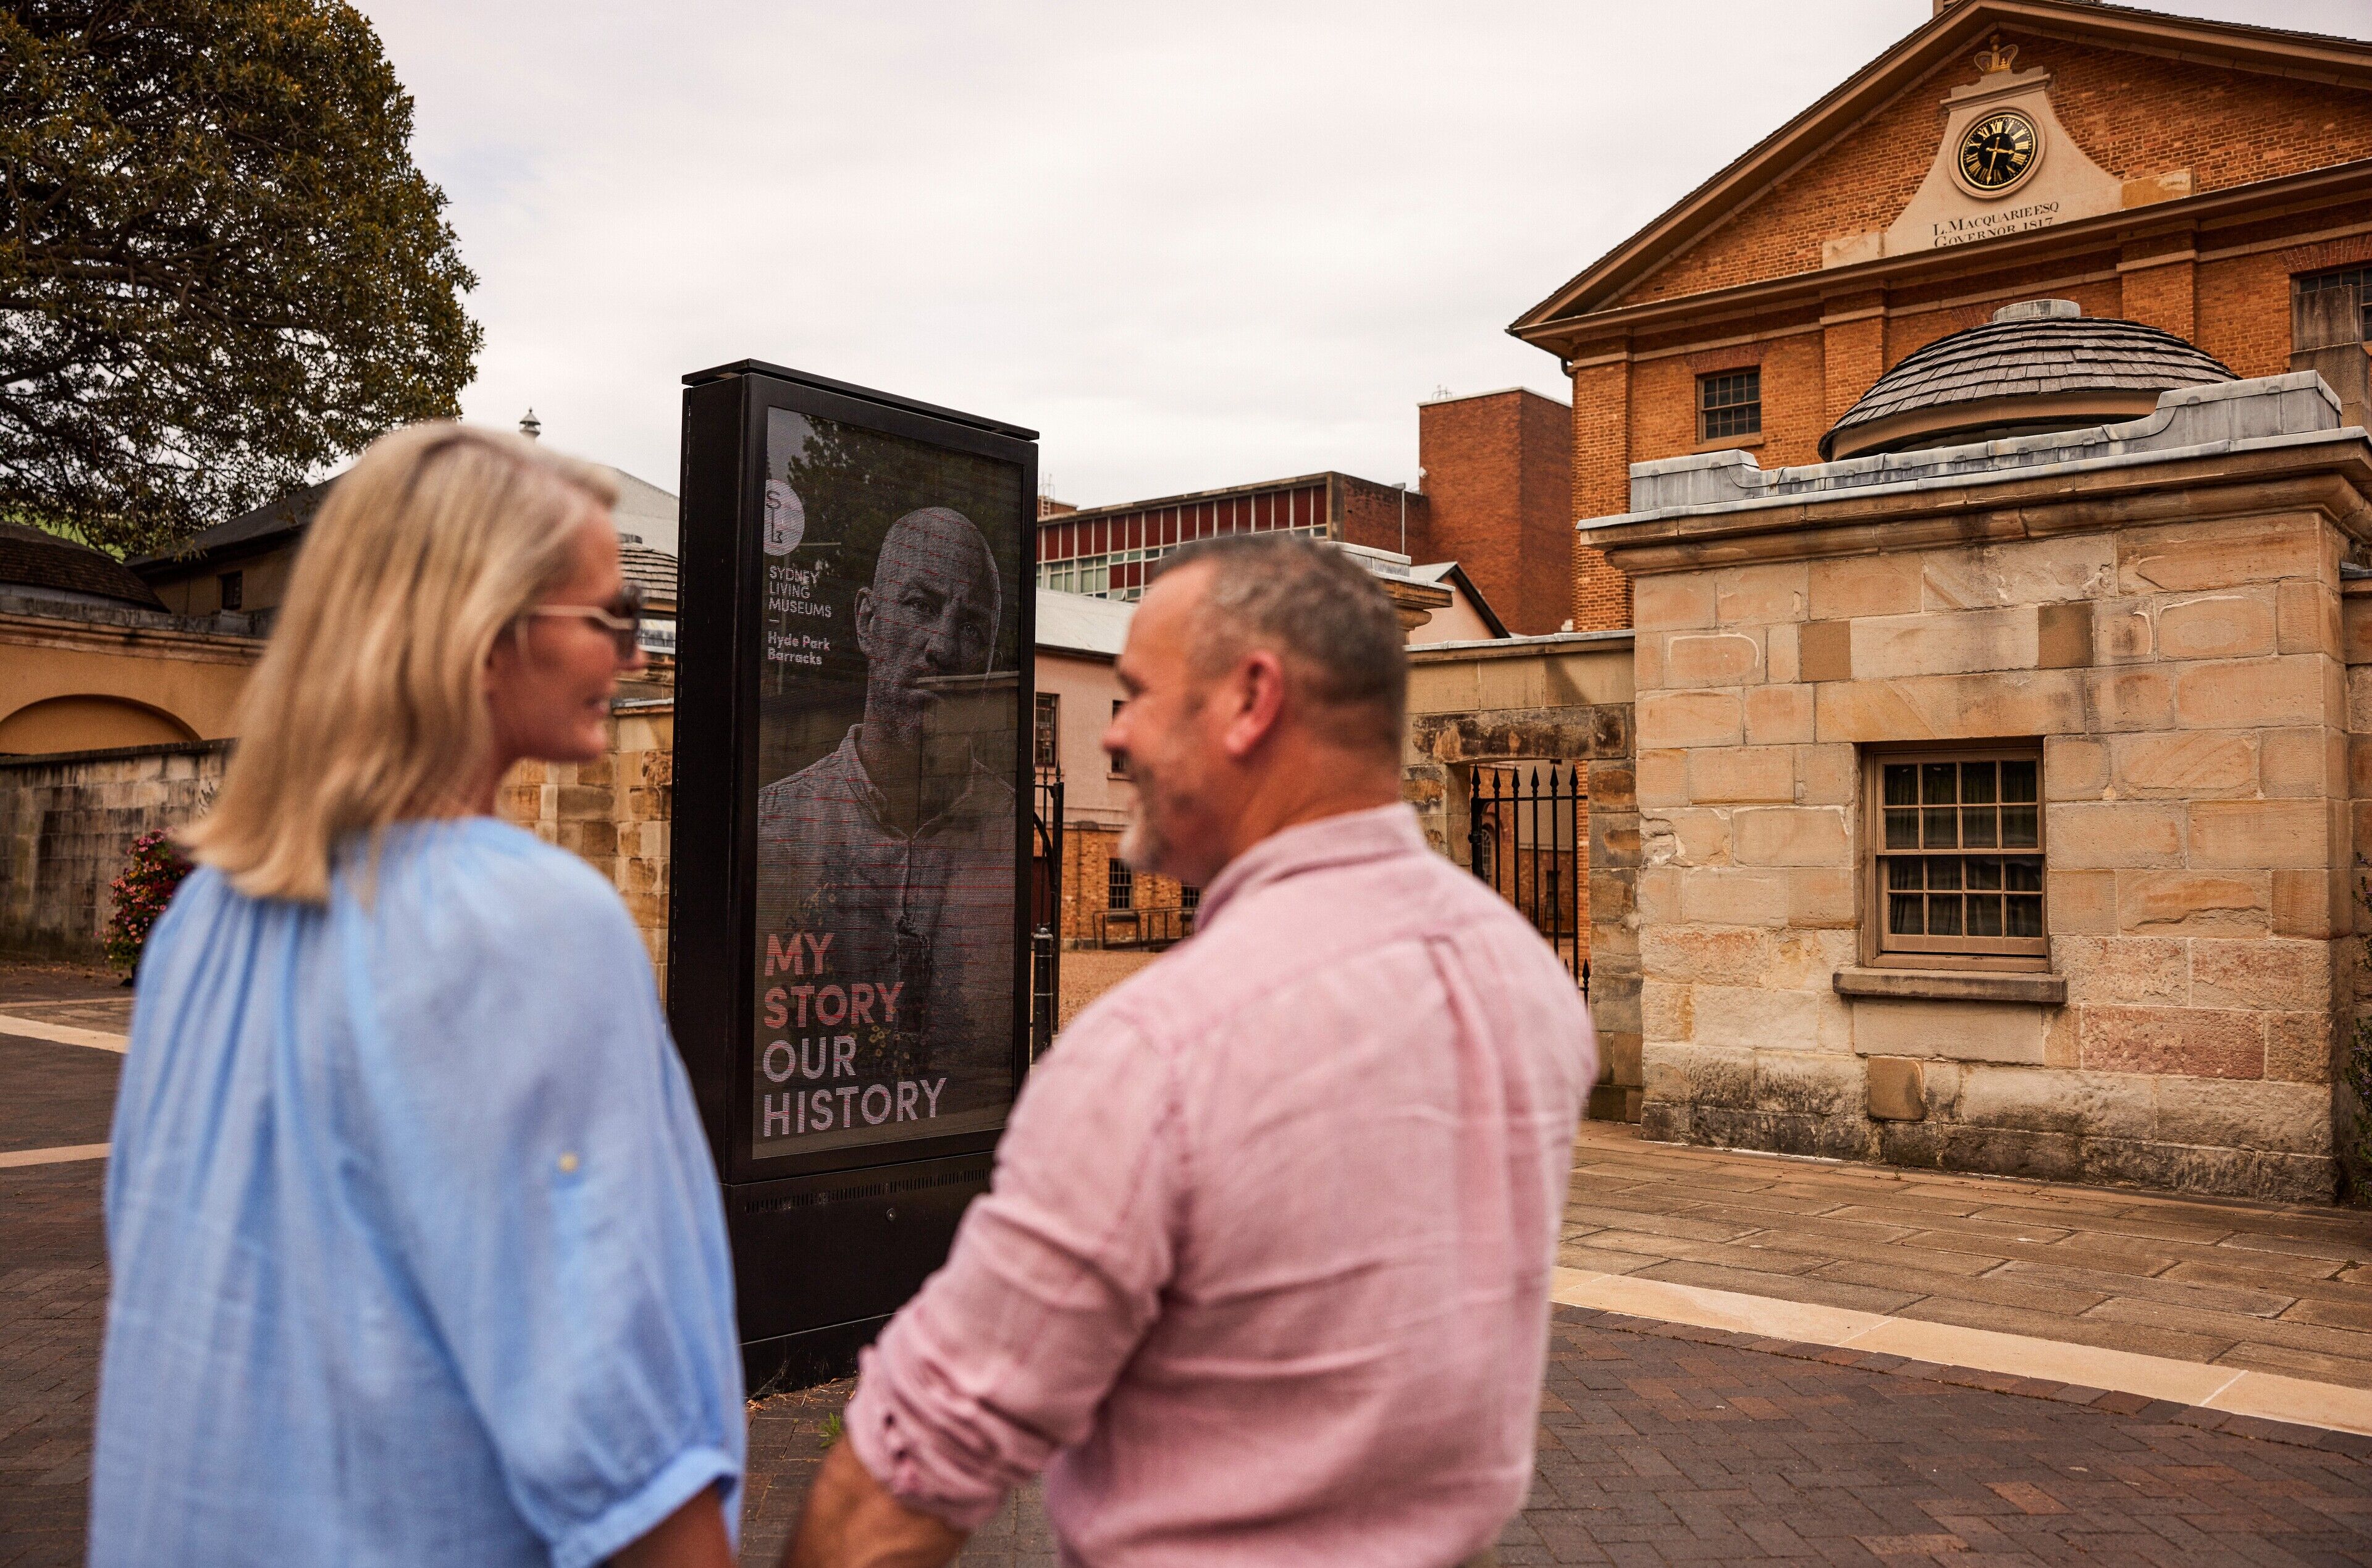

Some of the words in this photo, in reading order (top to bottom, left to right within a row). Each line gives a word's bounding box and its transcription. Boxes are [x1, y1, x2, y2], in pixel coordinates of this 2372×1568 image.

[2023, 217, 2054, 231] 1817
[769, 565, 820, 585] SYDNEY
[769, 581, 810, 599] LIVING
[768, 597, 832, 618] MUSEUMS
[768, 631, 799, 648] Hyde
[802, 635, 830, 652] Park
[767, 647, 822, 665] Barracks
[764, 933, 835, 976] MY
[763, 981, 905, 1029] STORY
[762, 1035, 858, 1083] OUR
[763, 1077, 948, 1137] HISTORY
